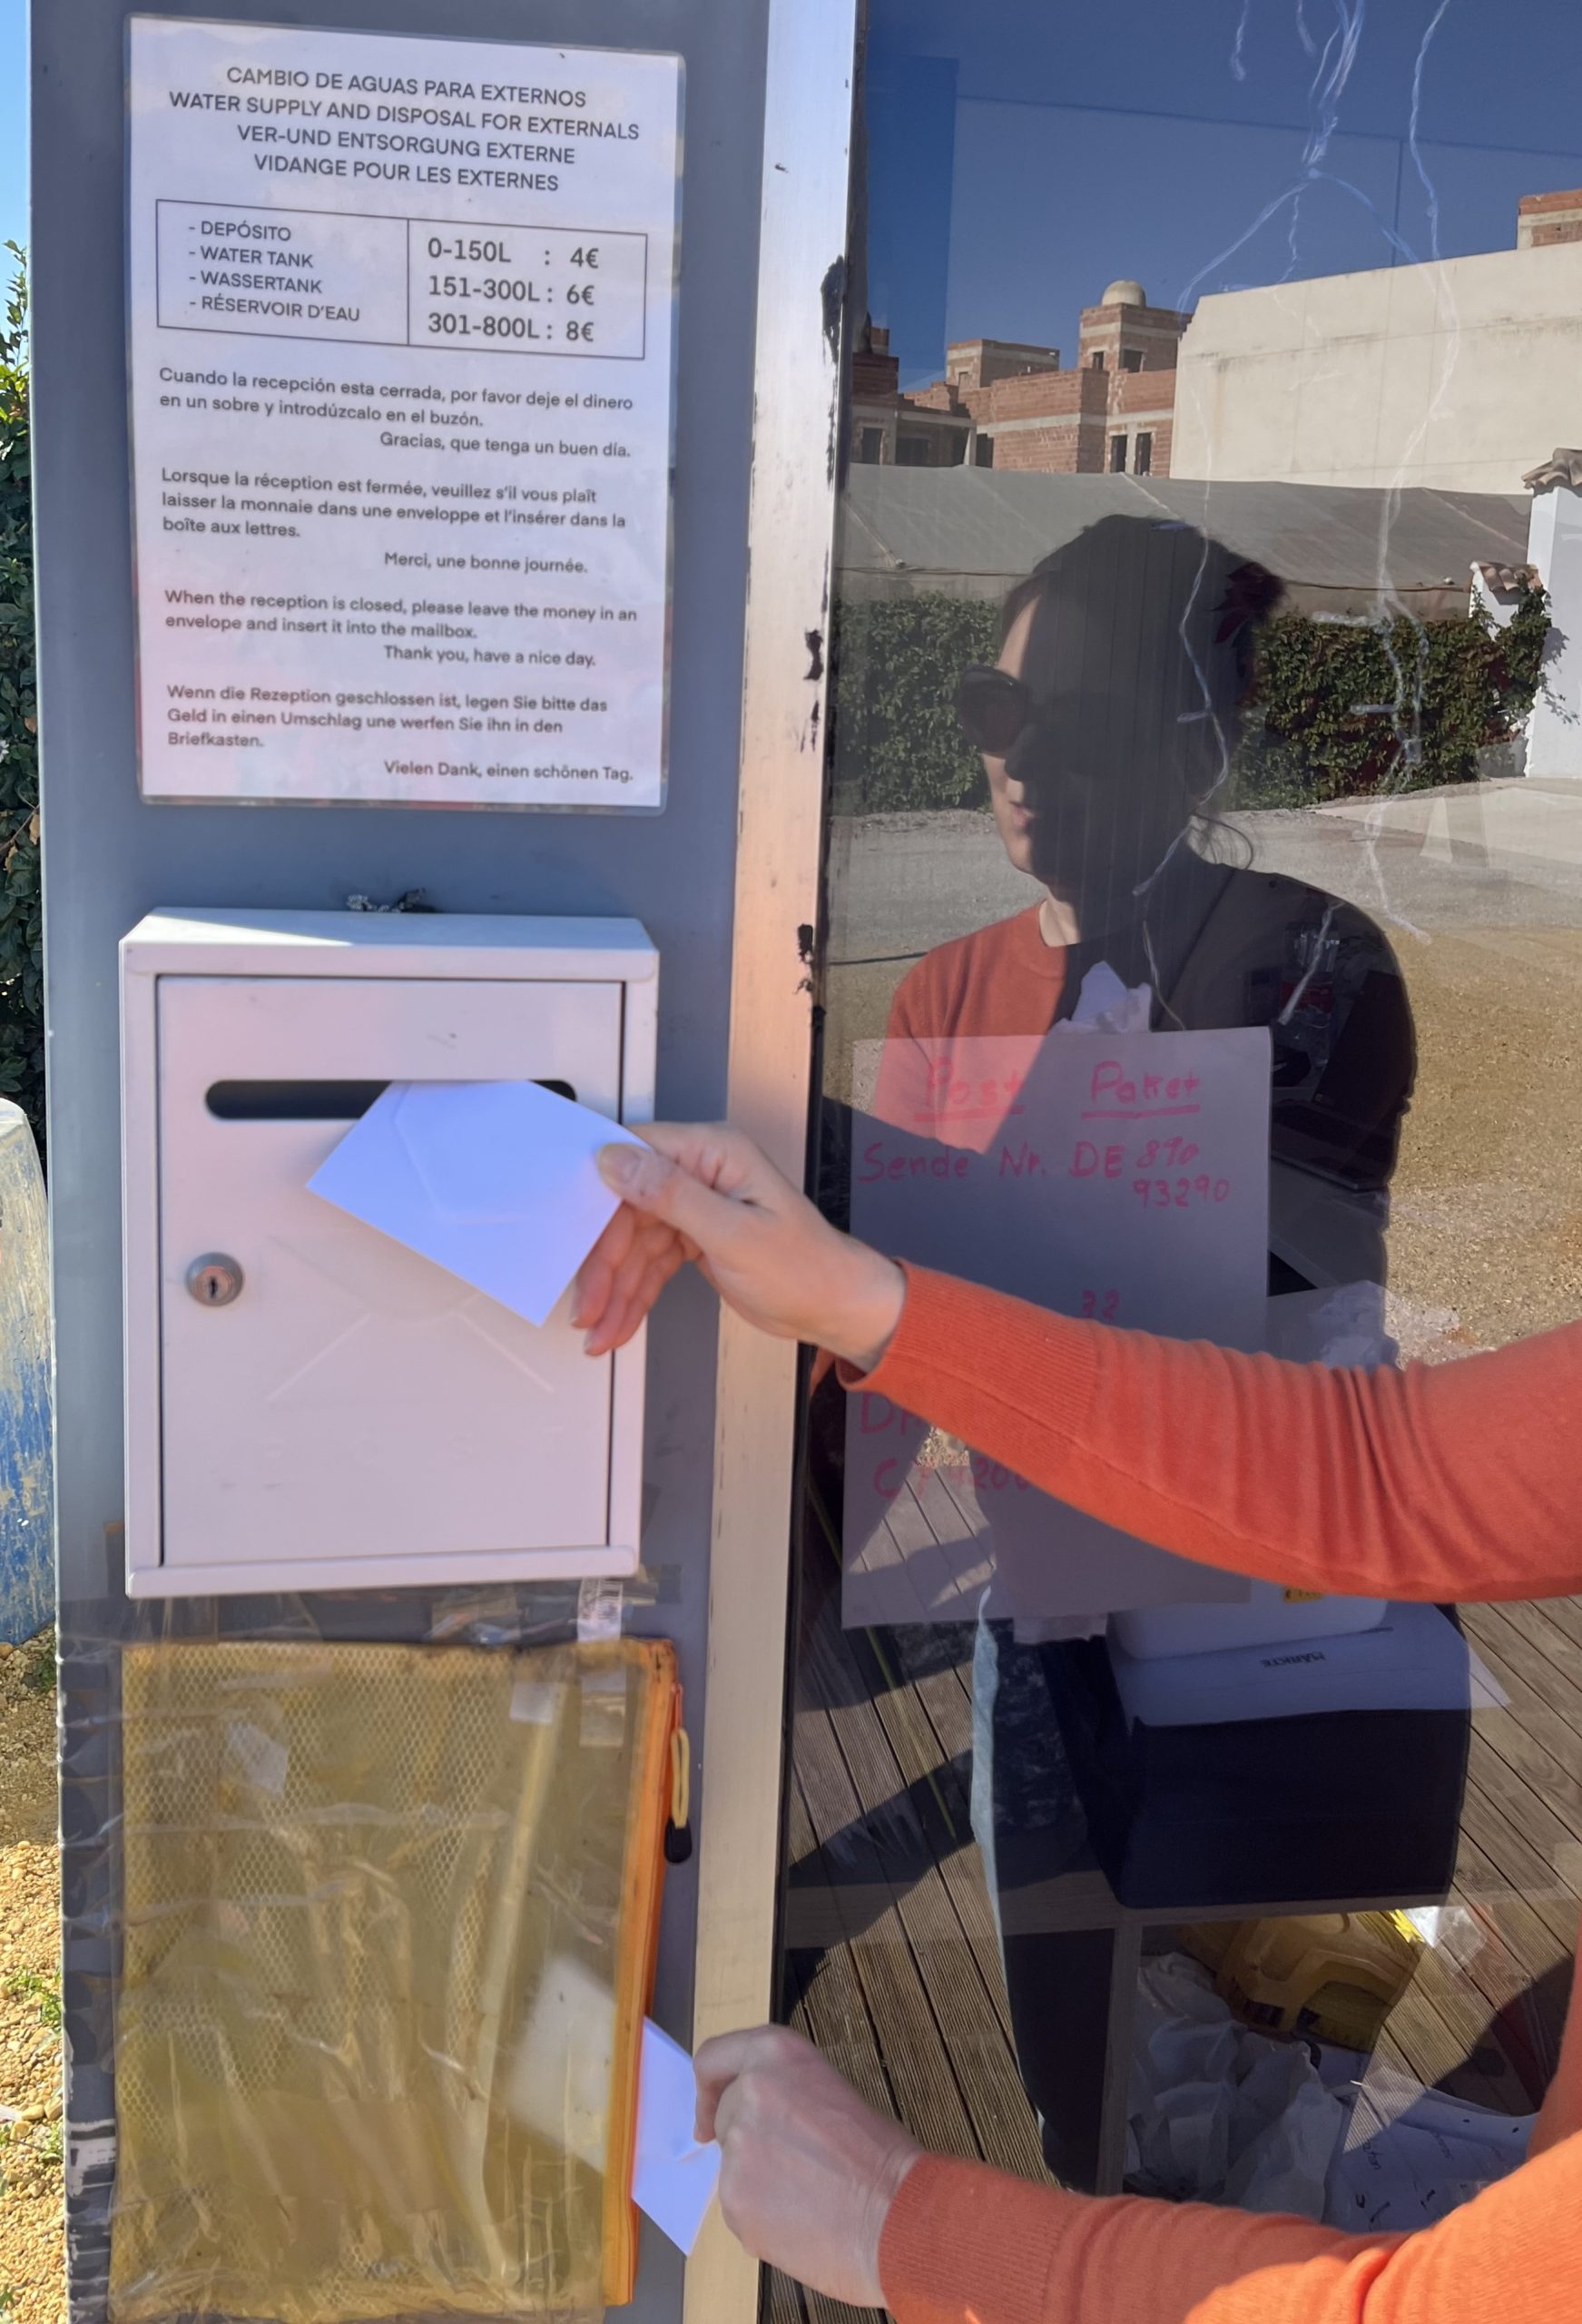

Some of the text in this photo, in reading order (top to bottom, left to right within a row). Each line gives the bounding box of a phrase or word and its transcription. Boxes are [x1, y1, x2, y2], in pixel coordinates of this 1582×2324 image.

[226, 66, 587, 108] CAMBIO DE AGUAS PARA EXTERNOS
[168, 91, 640, 141] WATER SUPPLY AND DISPOSAL FOR EXTERNALS
[236, 123, 575, 165] VER-UND ENTSORGUNG EXTERNE
[253, 153, 560, 192] VIDANGE POUR LES EXTERNES
[200, 220, 293, 242] DEPÓSITO
[200, 245, 263, 265] WATER
[266, 251, 314, 269] TANK
[427, 236, 512, 264] 0-150L
[569, 246, 599, 270] 4€
[200, 270, 323, 294] WASSERTANK
[428, 274, 541, 302] 151-300L
[565, 283, 595, 306] 6€
[201, 292, 303, 319] RÉSERVOIR
[427, 311, 541, 340] 301-800L
[565, 320, 595, 343] 8€
[158, 366, 634, 411] Cuando la recepción esta cerrada, por favor deje el dinero
[159, 394, 484, 428] en un sobre y introdúzcalo en el buzón.
[379, 431, 632, 458] Gracias, que tenga un buen día.
[161, 467, 231, 487] Lorsque
[234, 469, 251, 487] la
[253, 472, 334, 493] réception
[336, 478, 363, 494] est
[365, 478, 427, 498] fermée,
[430, 482, 492, 500] veuillez
[520, 488, 559, 503] vous
[562, 487, 597, 507] plaît
[162, 490, 218, 509] laisser
[220, 494, 237, 511] la
[240, 498, 314, 515] monnaie
[317, 500, 359, 517] dans
[361, 506, 393, 519] une
[395, 505, 481, 526] enveloppe
[484, 509, 501, 524] et
[569, 511, 609, 528] dans
[612, 512, 626, 528] la
[162, 516, 301, 538] boîte aux lettres.
[384, 551, 588, 575] Merci, une bonne journée.
[163, 589, 638, 624] When the reception is closed, please leave the money in an
[164, 613, 477, 639] envelope and insert it into the mailbox.
[383, 644, 596, 669] Thank you, have a nice day.
[166, 684, 608, 713] Wenn die Rezeption geschlossen ist, legen Sie bitte das
[167, 707, 564, 734] Geld in einen Umschlag une werfen Sie ihn in den
[167, 731, 266, 748] Briefkasten.
[383, 759, 634, 784] Vielen Dank, einen schönen Tag.
[926, 1056, 1025, 1108] Post
[859, 1142, 970, 1182] Sende
[1069, 1140, 1125, 1178] DE
